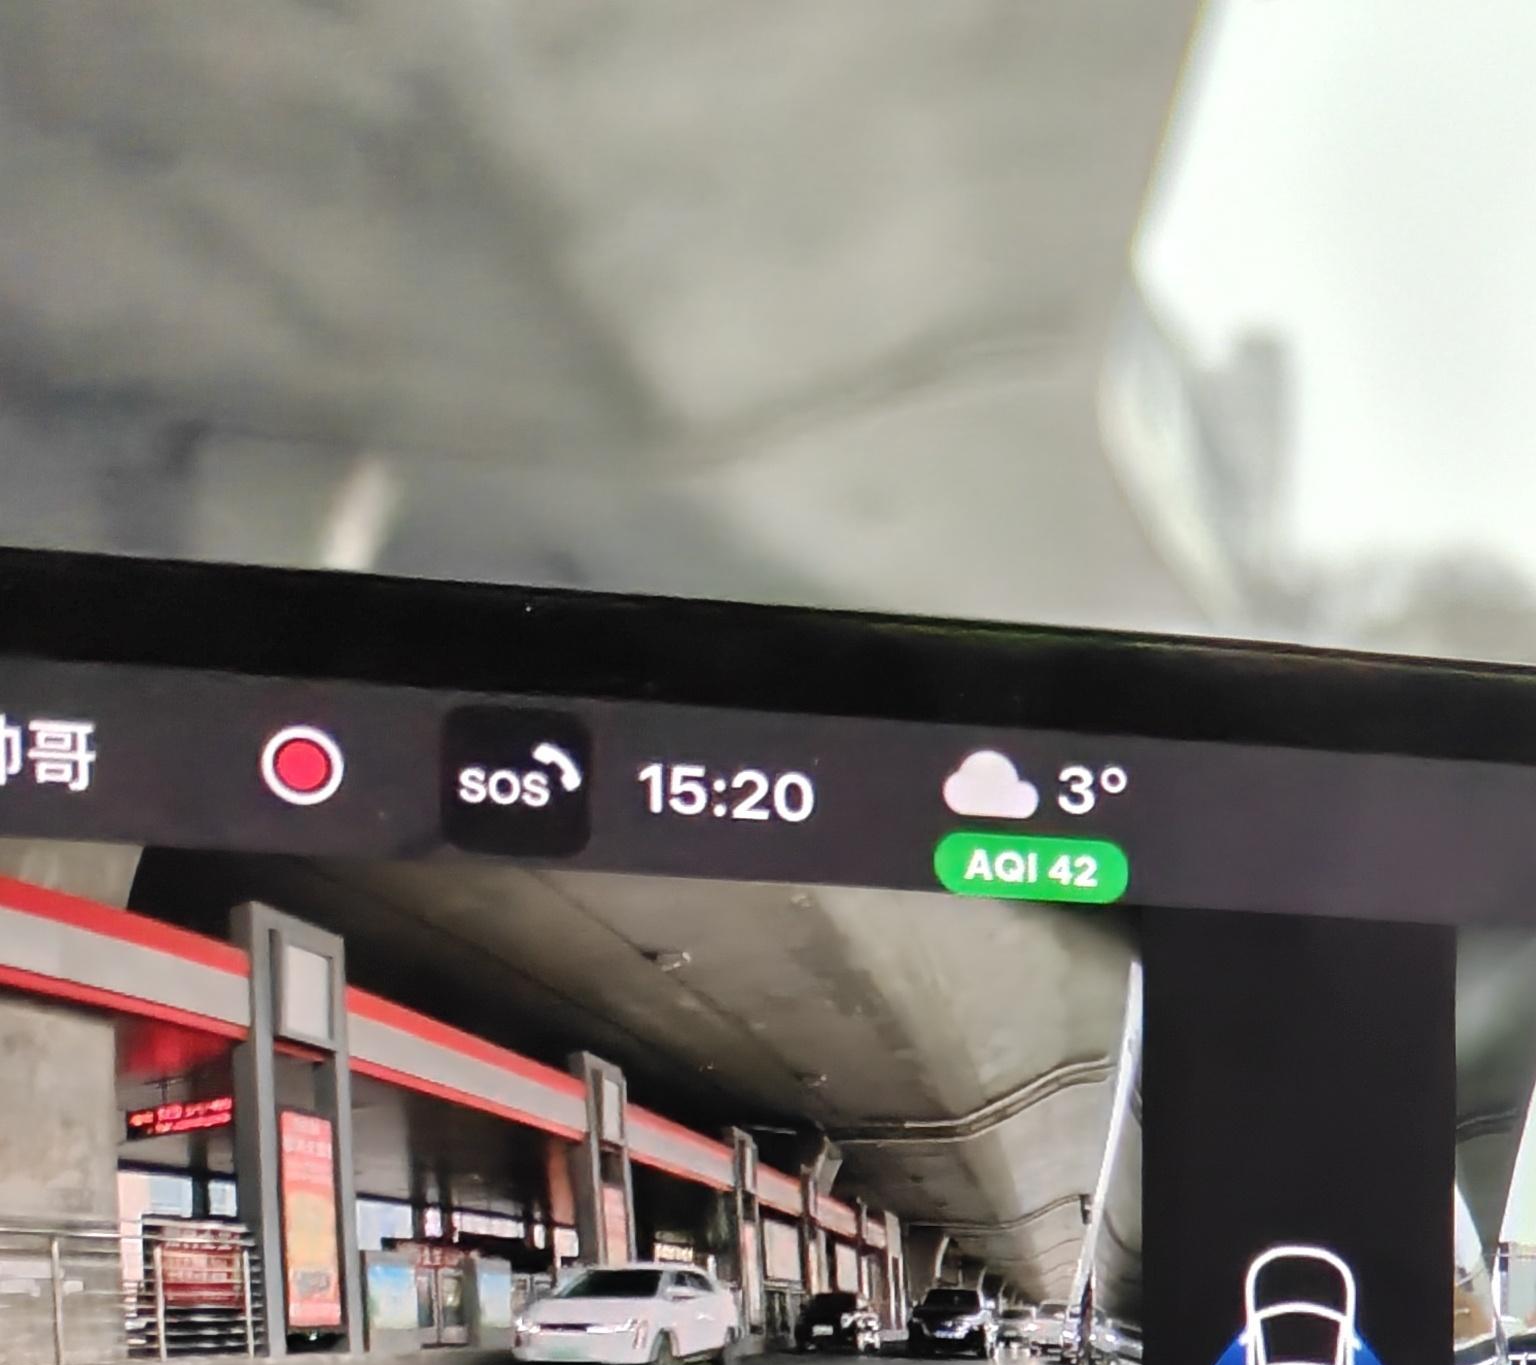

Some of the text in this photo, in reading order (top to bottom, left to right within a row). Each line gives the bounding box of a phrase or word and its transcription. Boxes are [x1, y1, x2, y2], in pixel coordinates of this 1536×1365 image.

[458, 766, 551, 807] SOS
[638, 763, 814, 822] 15:20
[1057, 765, 1128, 815] 3°
[964, 849, 1098, 888] AQI 42
